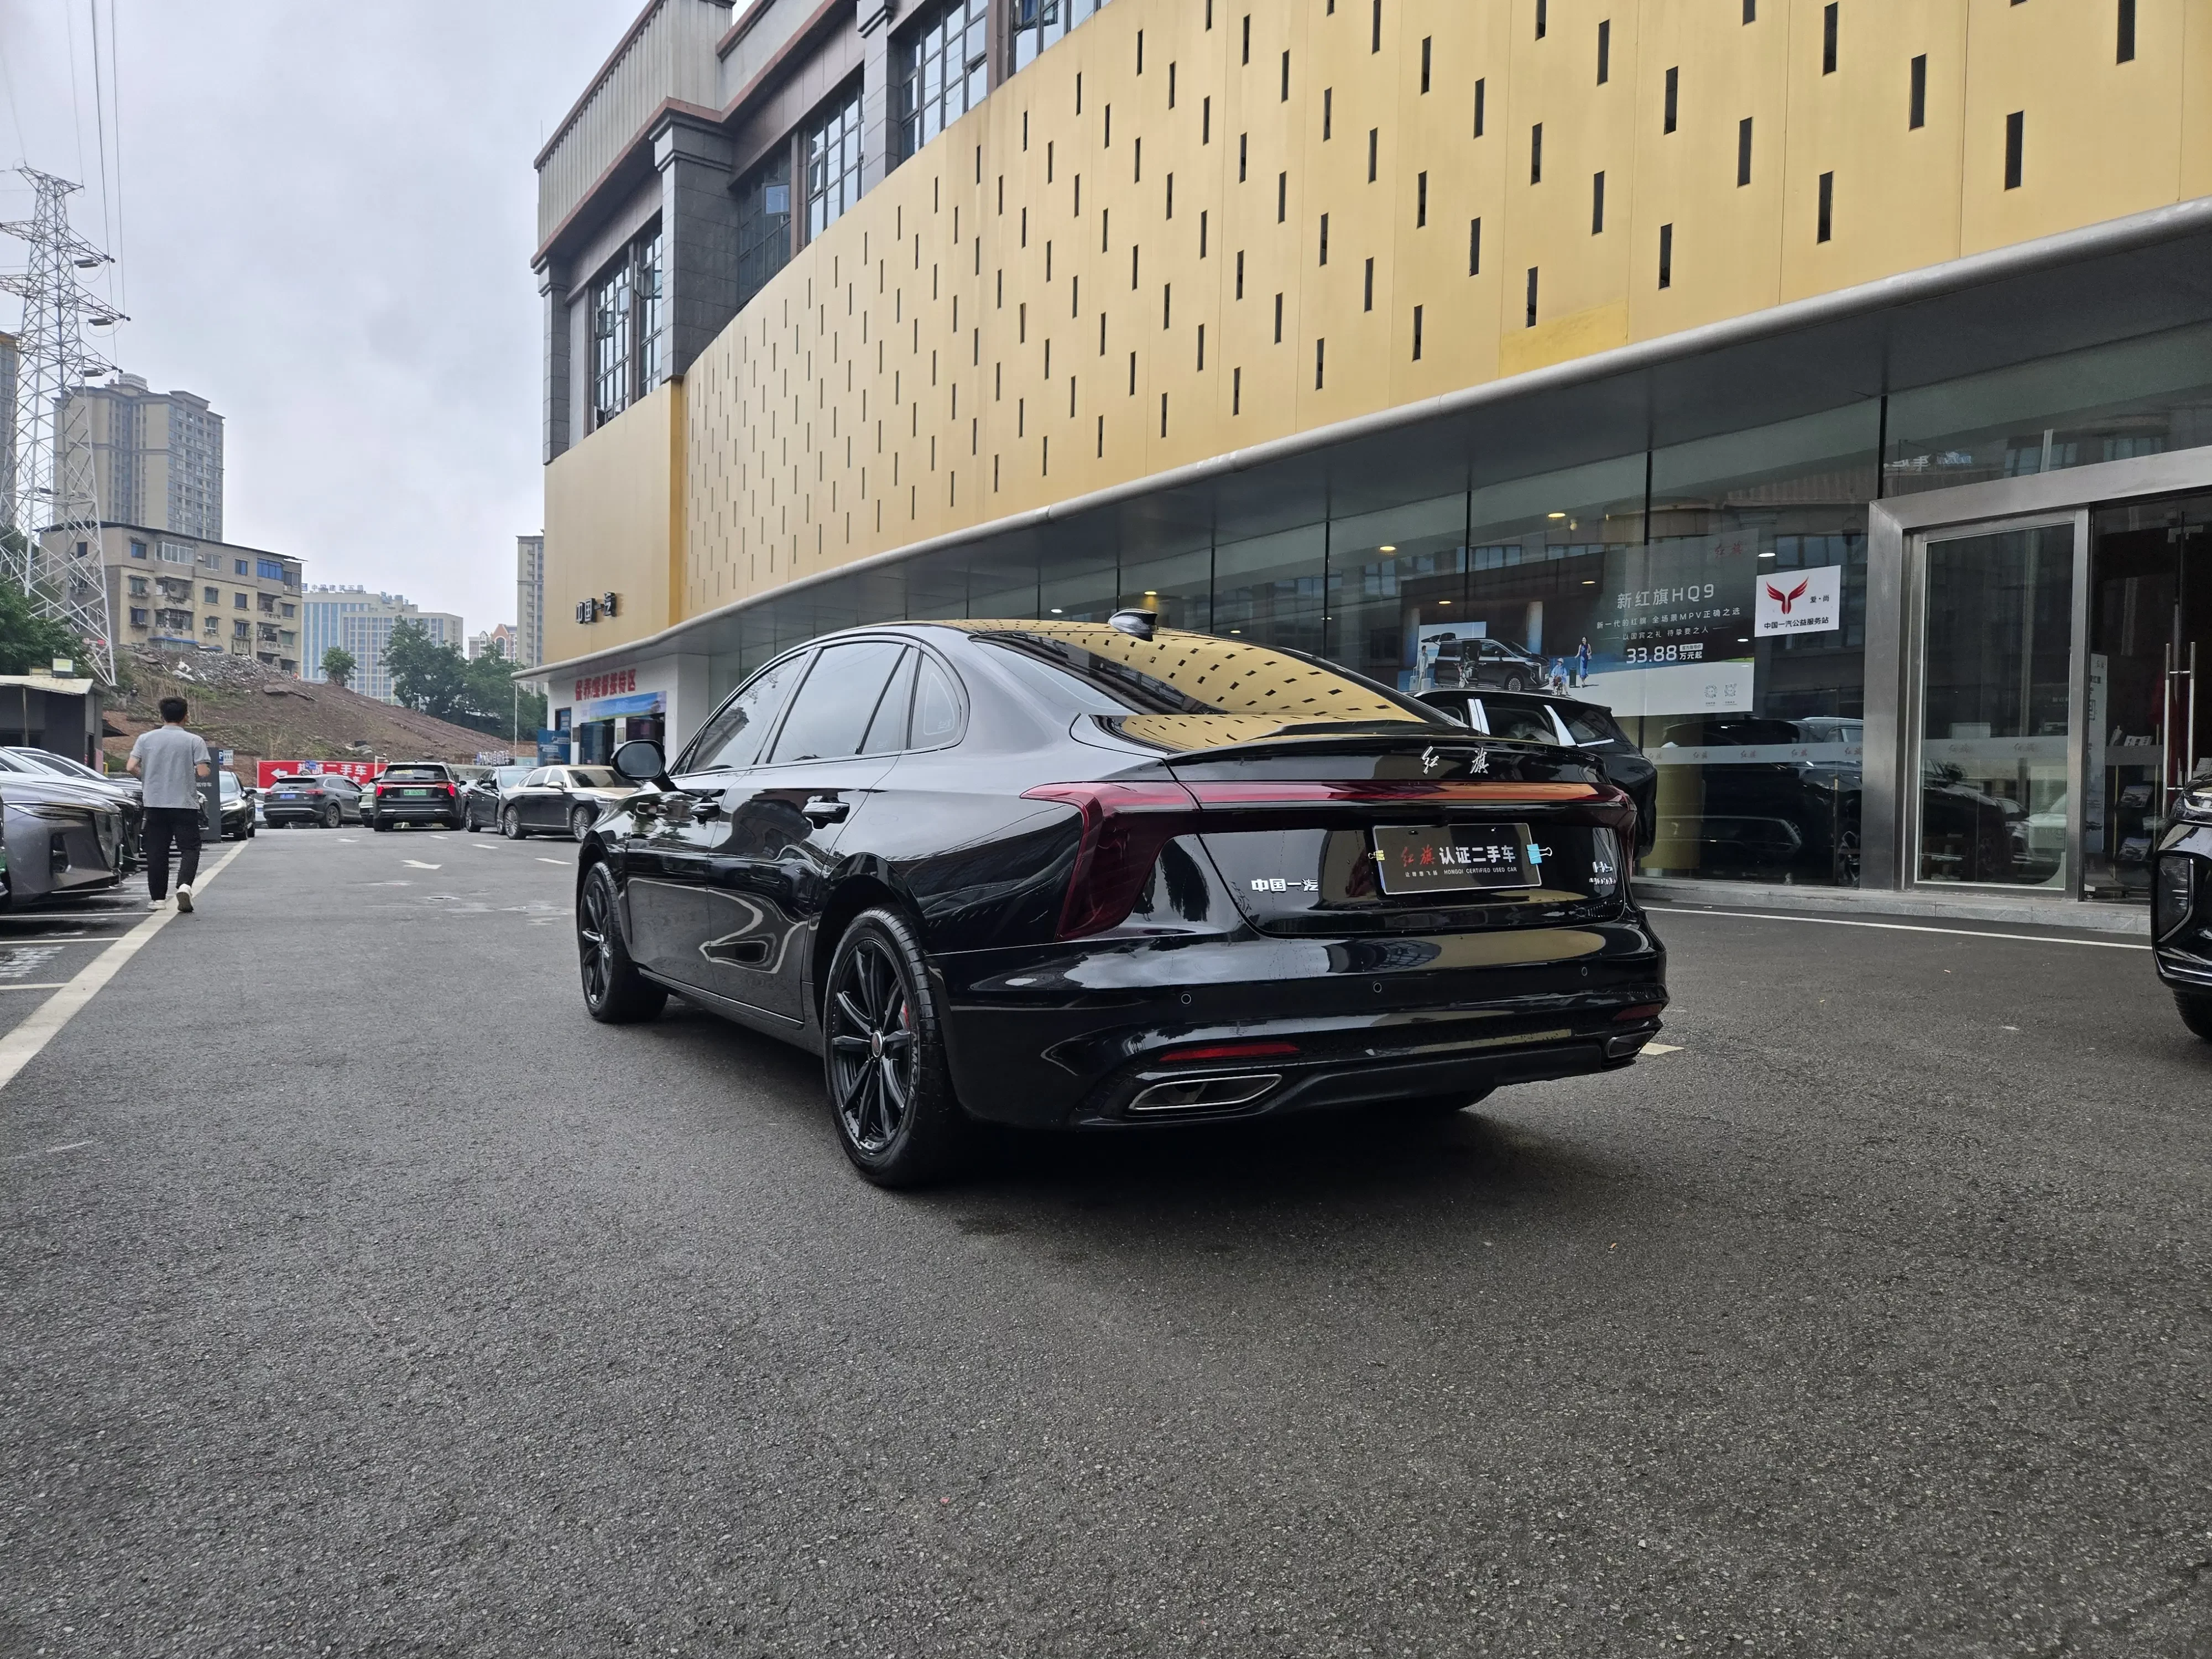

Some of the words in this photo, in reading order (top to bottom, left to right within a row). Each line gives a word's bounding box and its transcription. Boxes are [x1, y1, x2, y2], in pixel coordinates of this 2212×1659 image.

[1616, 583, 1714, 609] 新红旗HQ9
[576, 591, 615, 624] 中国一汽
[1597, 617, 1647, 629] 新一代的红旗
[1764, 617, 1829, 629] 中国一汽公益服务站
[1623, 630, 1662, 640] 以国宾之礼
[1626, 645, 1677, 664] 33.88
[1679, 651, 1703, 660] 万元起
[1420, 746, 1489, 774] 红旗
[1439, 845, 1516, 864] 认证二手车
[1251, 878, 1319, 893] 中国一汽
